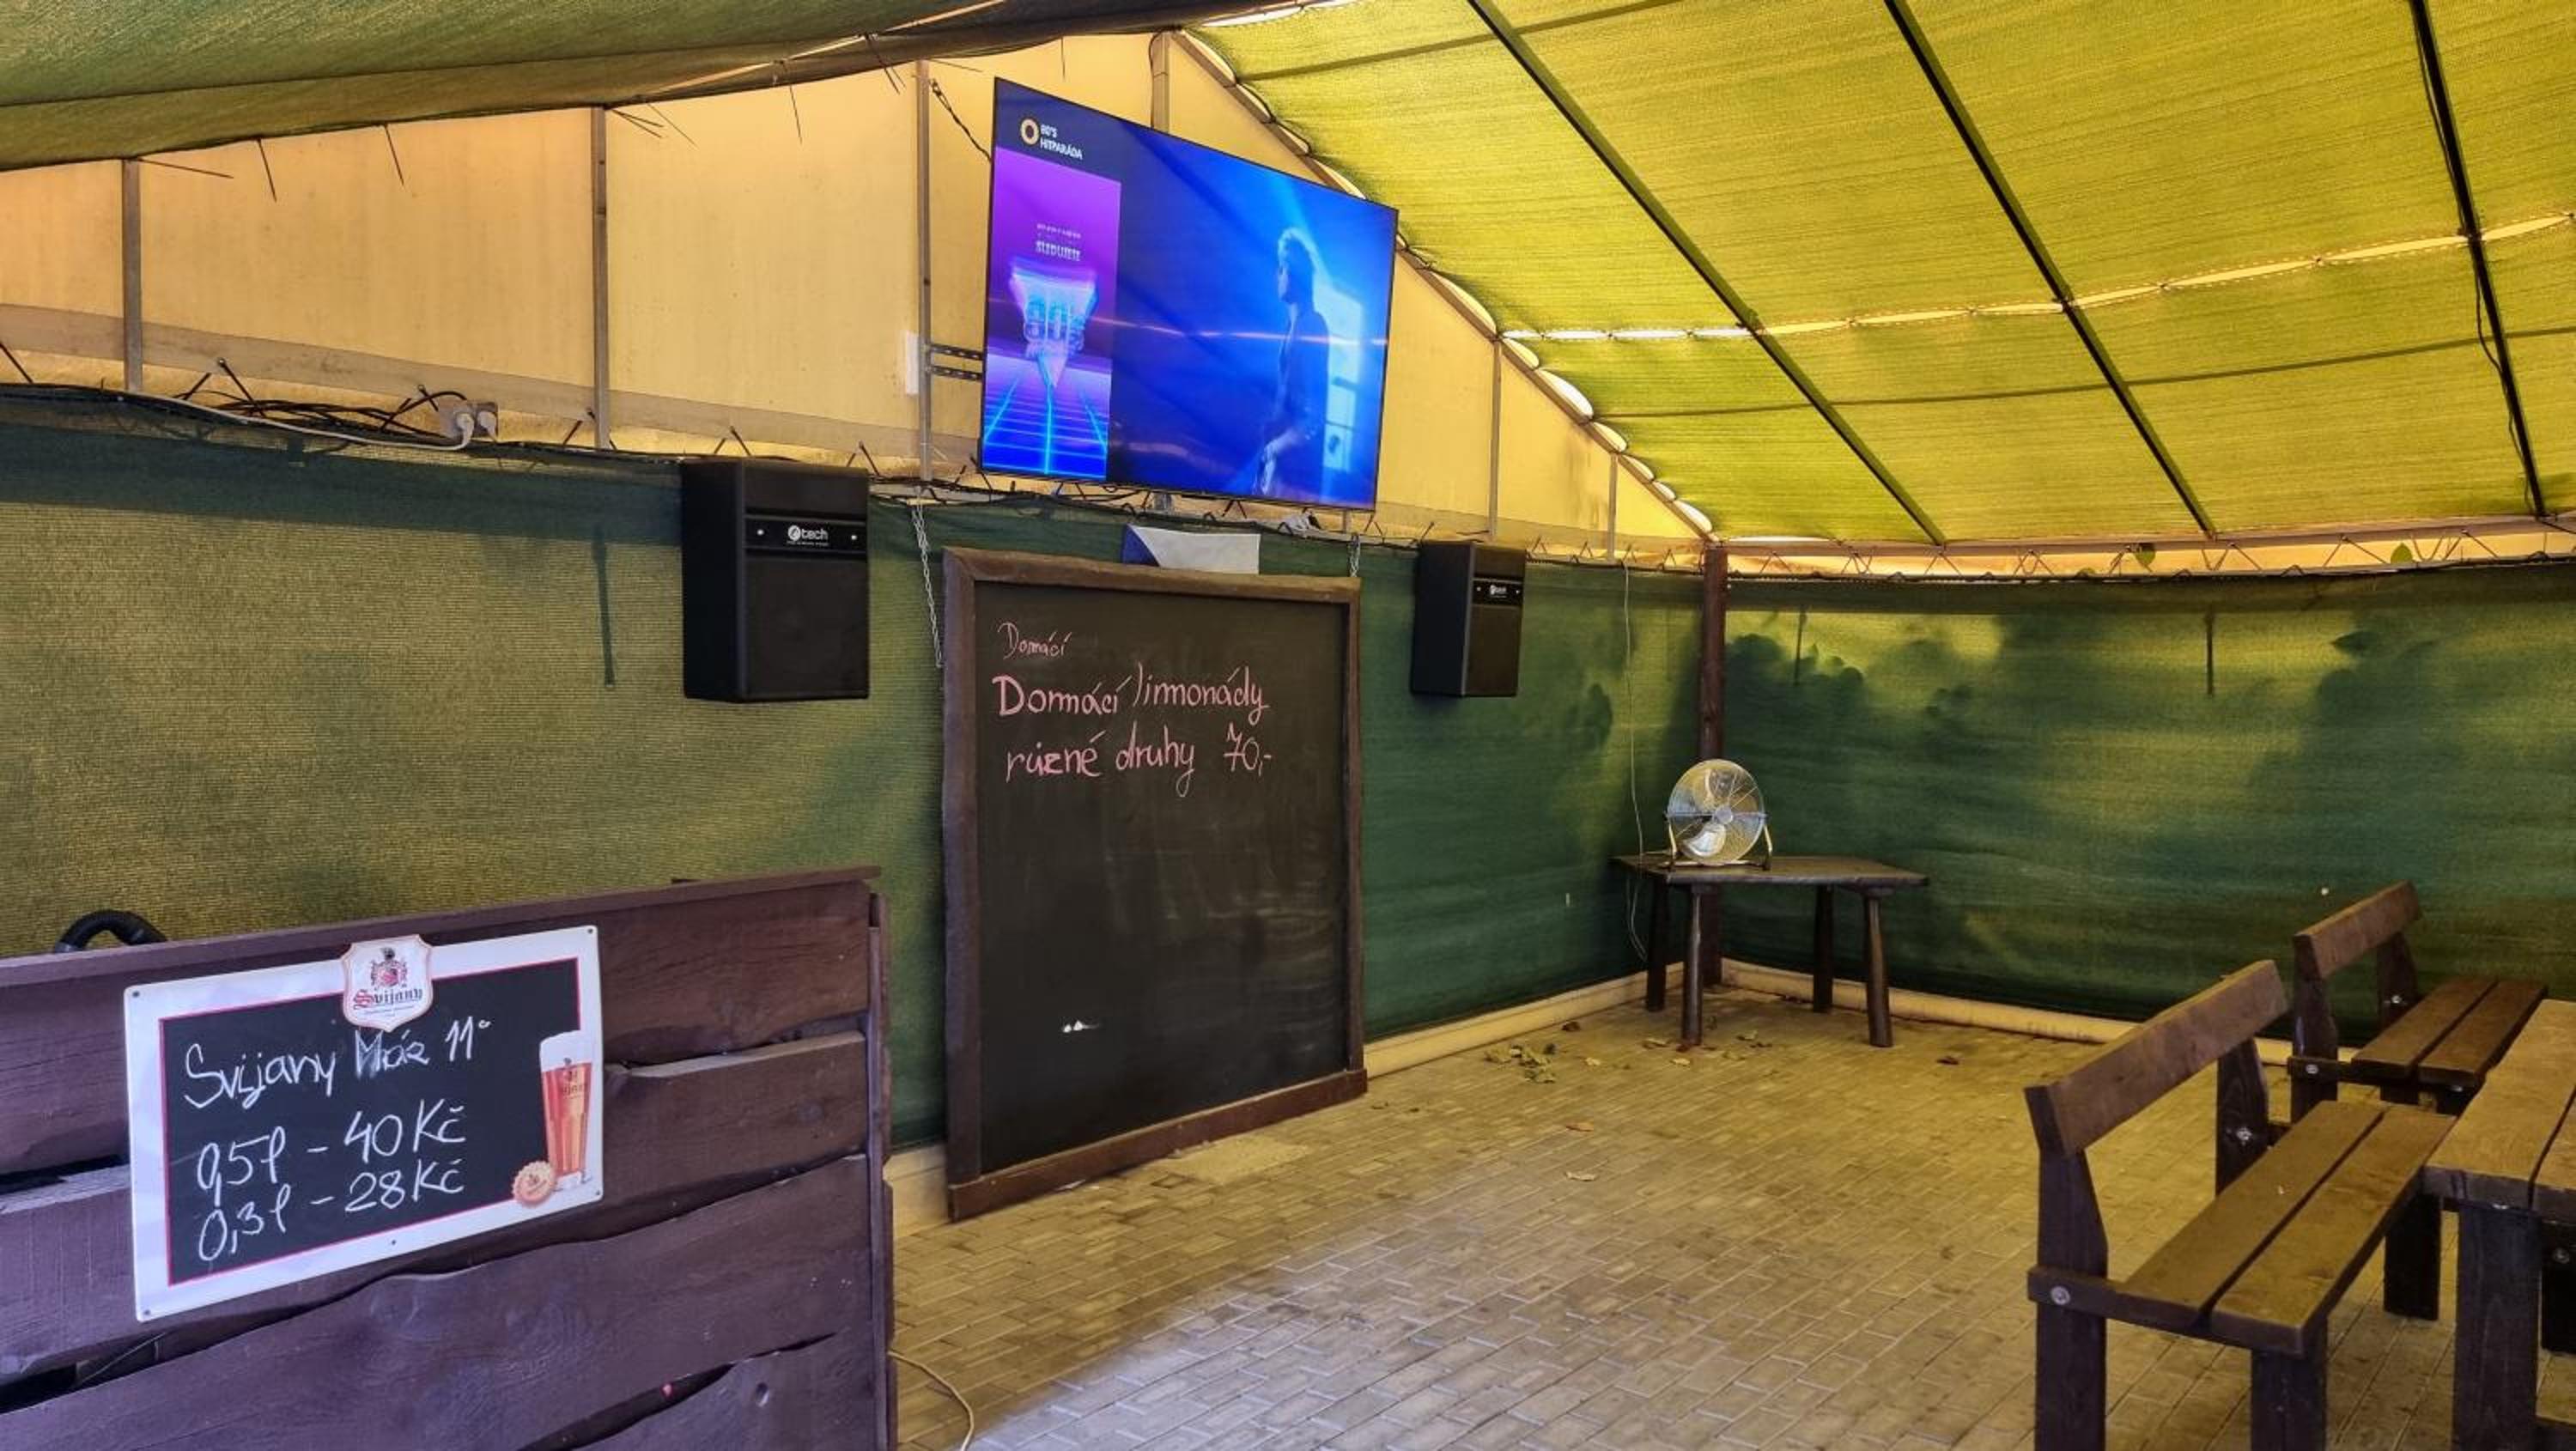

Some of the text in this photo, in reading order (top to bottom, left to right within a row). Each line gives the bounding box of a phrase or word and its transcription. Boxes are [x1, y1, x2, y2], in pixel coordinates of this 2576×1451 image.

[997, 622, 1072, 659] Domácí
[992, 661, 1270, 726] Domácí limonády
[1115, 720, 1195, 798] druhy
[1223, 721, 1273, 777] 70,-
[353, 987, 423, 1011] Svijany
[185, 1043, 336, 1109] Svijany
[343, 1110, 404, 1164] 40
[412, 1099, 466, 1153] Kč
[198, 1184, 291, 1261] 0,3l
[344, 1169, 406, 1212] 28
